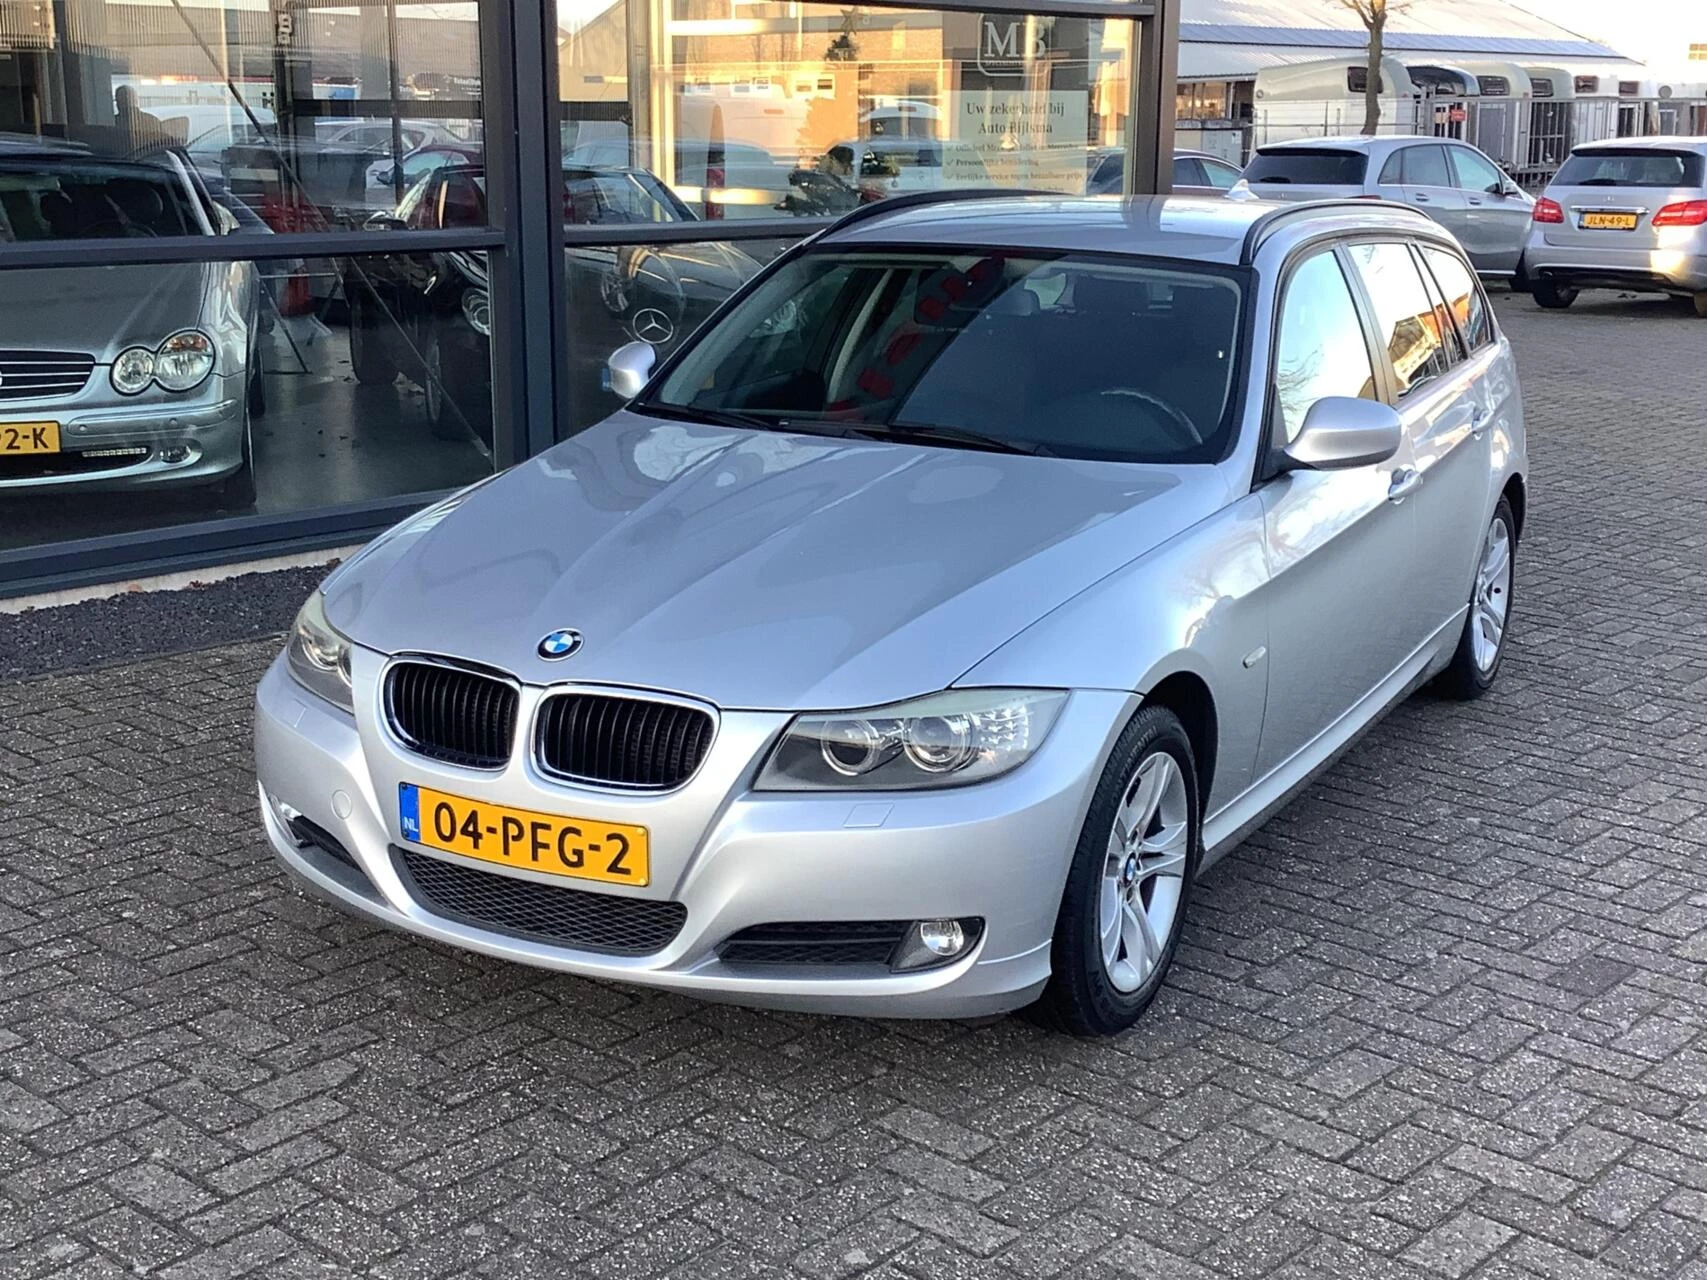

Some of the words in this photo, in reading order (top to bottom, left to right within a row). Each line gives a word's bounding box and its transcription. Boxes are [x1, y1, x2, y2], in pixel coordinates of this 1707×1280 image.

[966, 102, 986, 115] Uw
[1048, 101, 1065, 117] bij
[977, 121, 1006, 134] Auto
[1587, 214, 1631, 226] JLN-49-L
[0, 427, 49, 450] 2-K
[403, 817, 419, 833] NL
[434, 801, 632, 876] 04-PFG-2
